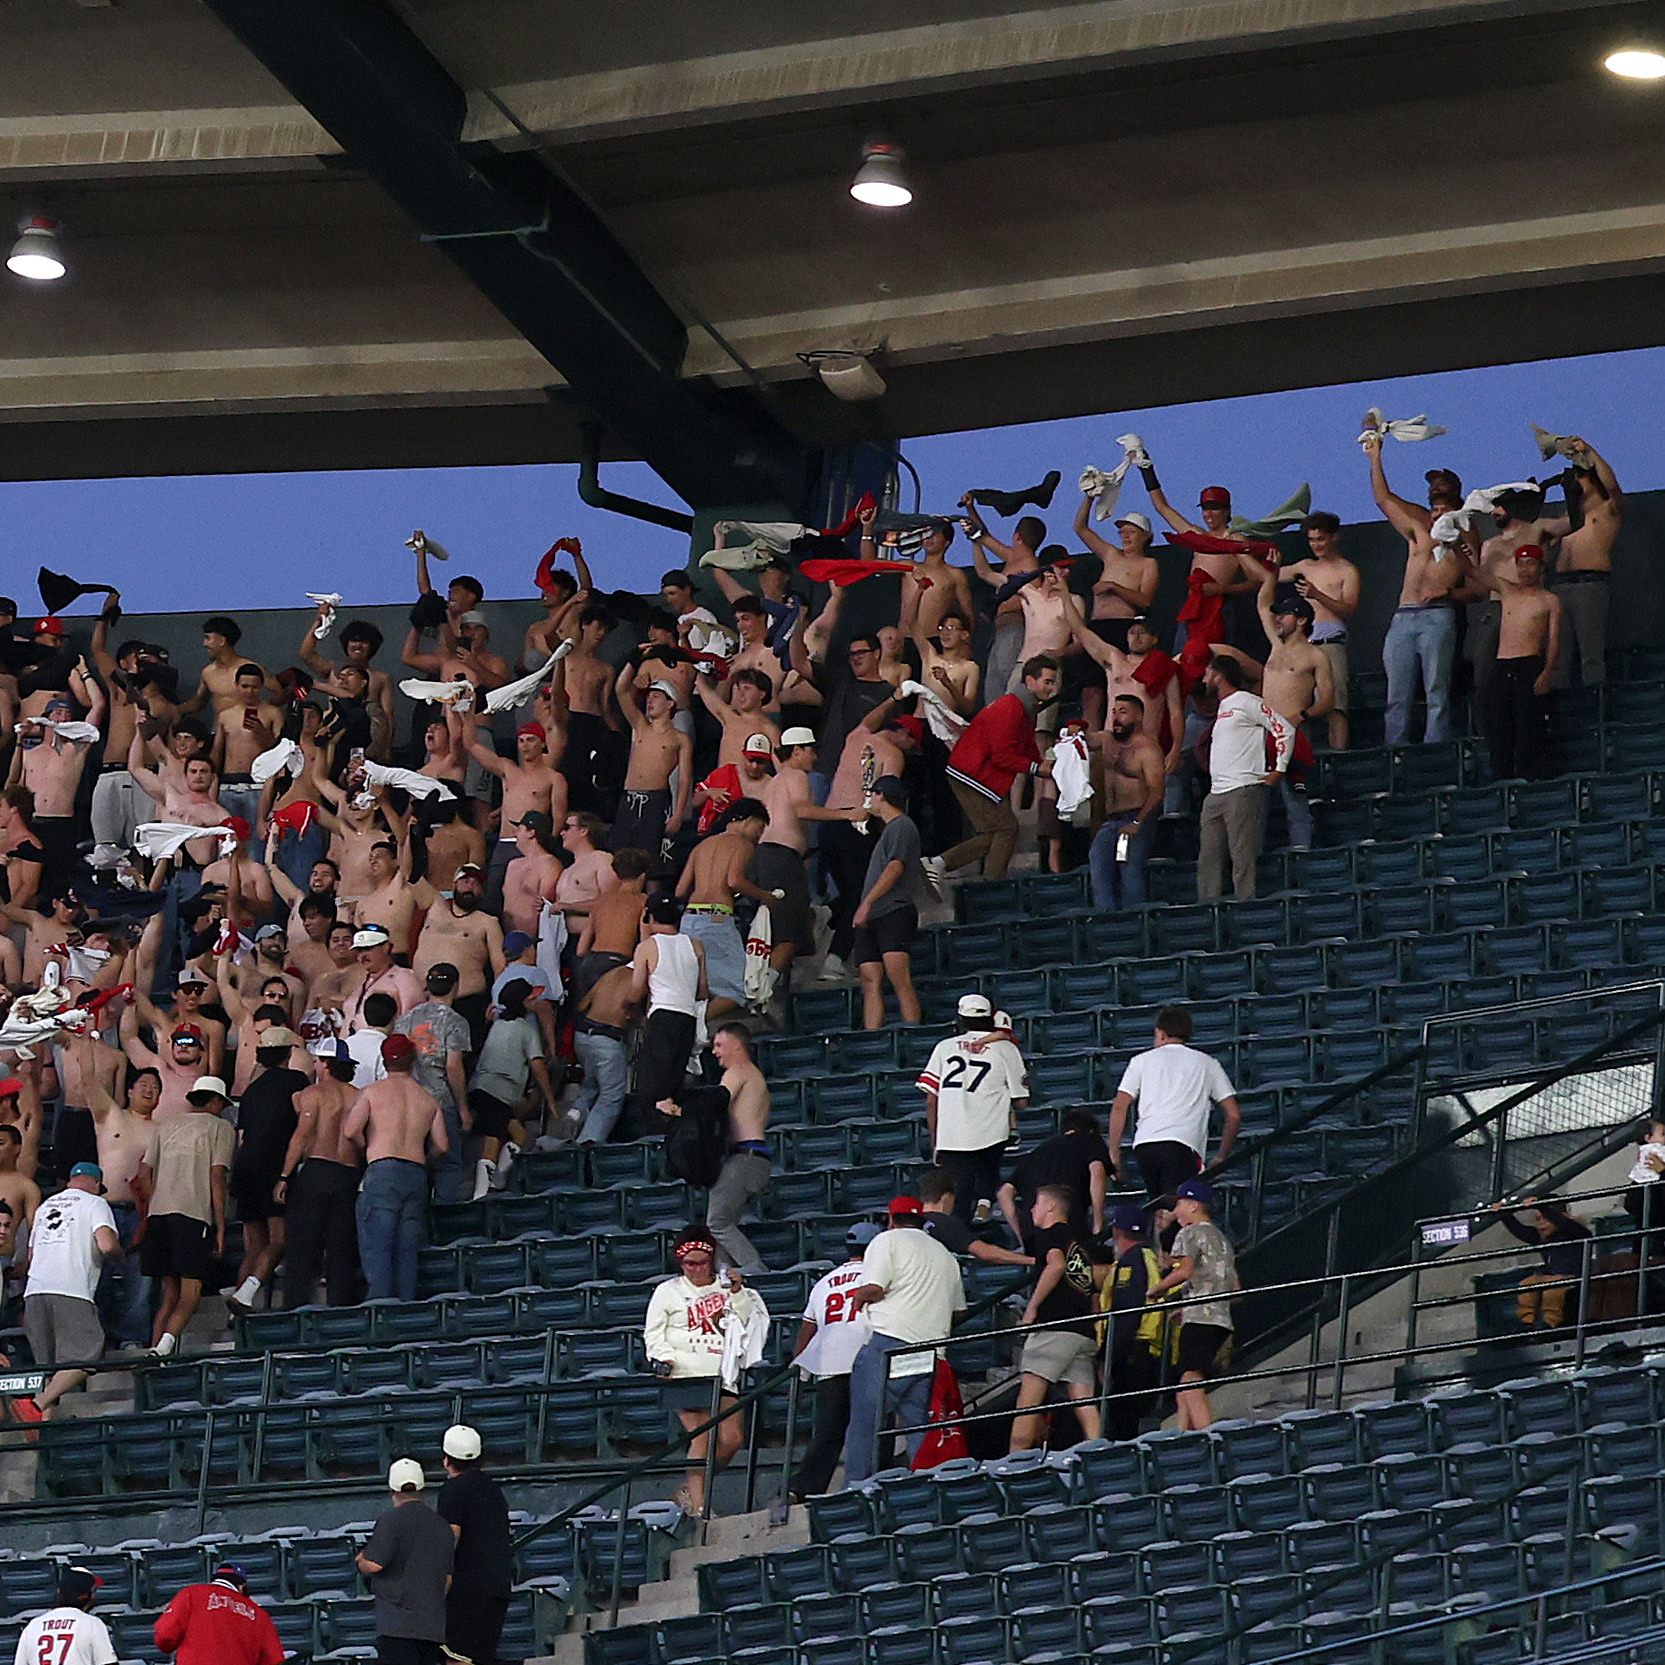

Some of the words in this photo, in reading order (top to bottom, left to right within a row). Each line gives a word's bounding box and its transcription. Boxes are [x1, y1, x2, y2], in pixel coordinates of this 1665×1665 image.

[942, 1056, 991, 1092] 27
[1422, 1228, 1452, 1243] SECTION
[828, 1272, 861, 1288] TROUT
[825, 1289, 861, 1325] 27
[43, 1619, 76, 1632] TROUT
[38, 1633, 75, 1665] 27
